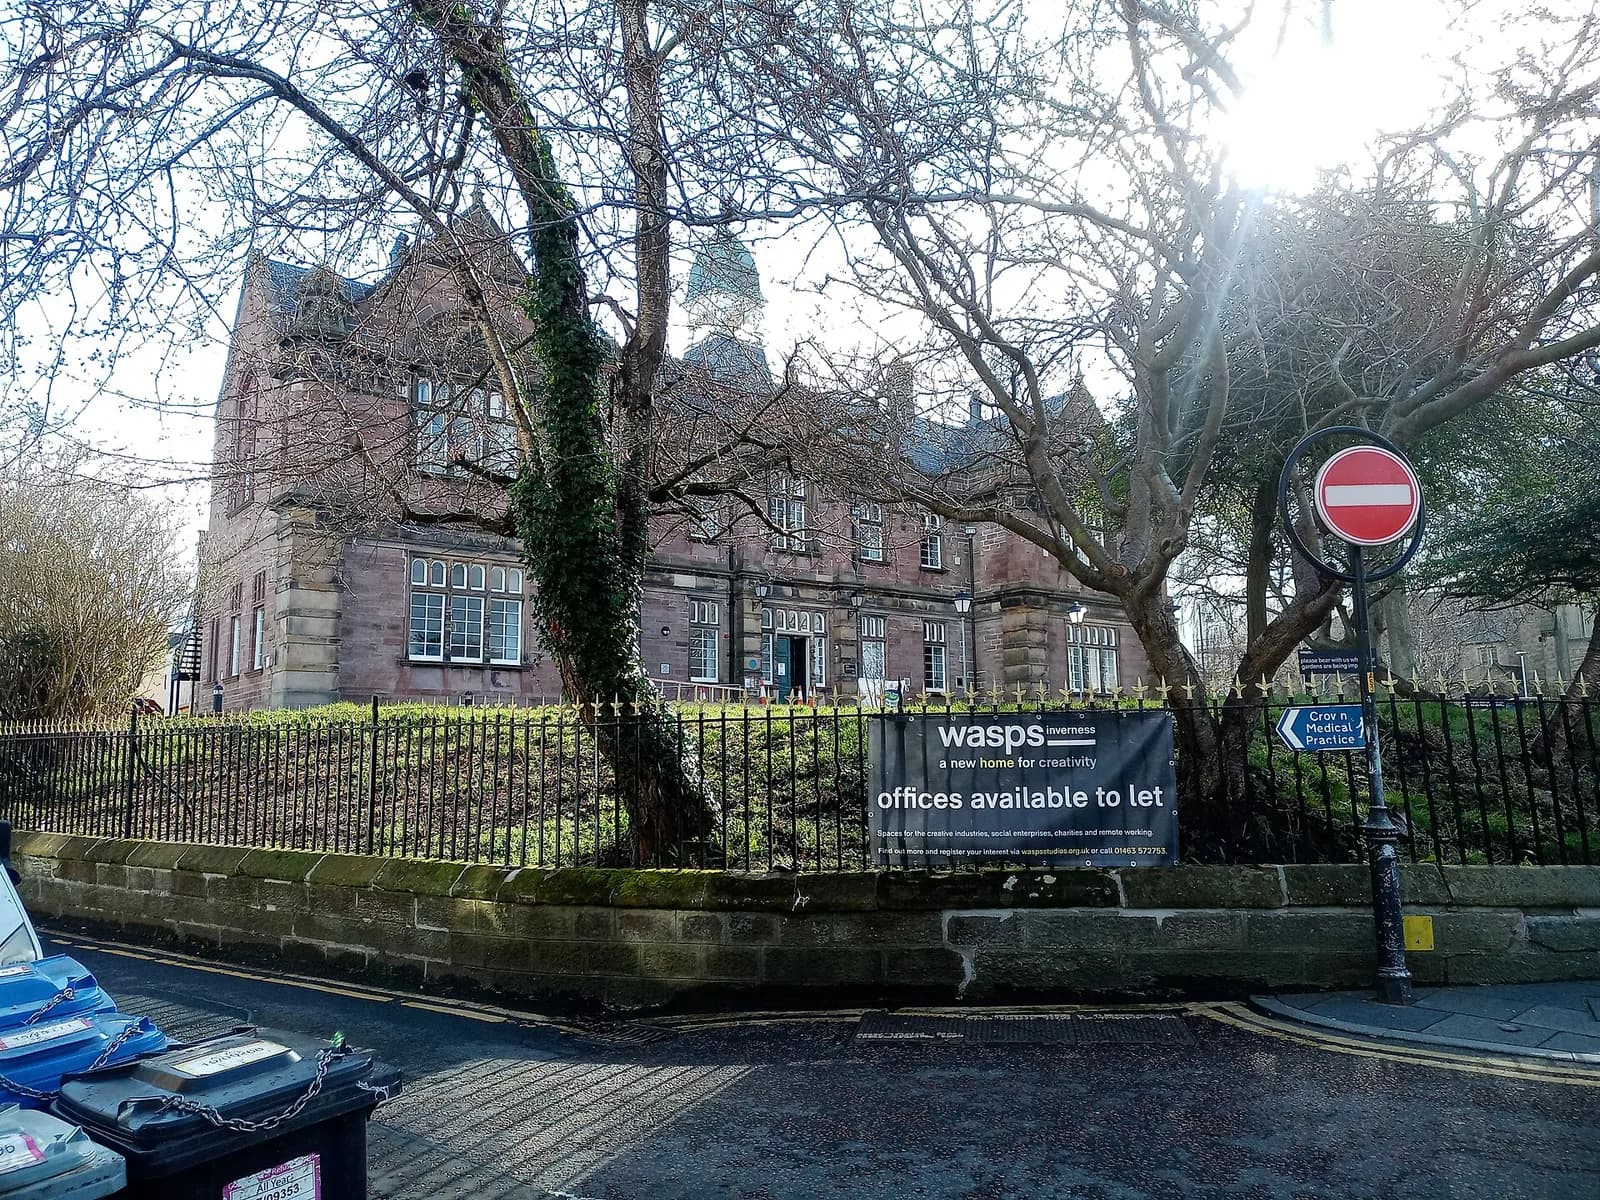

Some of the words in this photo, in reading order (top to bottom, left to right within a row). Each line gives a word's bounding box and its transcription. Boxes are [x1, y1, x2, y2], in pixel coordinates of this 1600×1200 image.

[1306, 722, 1352, 733] Medical
[938, 724, 1045, 755] wasps
[1046, 726, 1096, 734] inverness
[1306, 734, 1355, 745] Practice
[940, 760, 947, 768] a
[950, 760, 976, 768] new
[980, 757, 1014, 768] home
[1018, 757, 1035, 768] for
[1039, 756, 1097, 770] creativity
[878, 786, 963, 809] offices
[971, 786, 1088, 809] available
[1096, 786, 1121, 808] to
[1130, 784, 1164, 807] let
[877, 830, 903, 838] Spaces
[955, 830, 990, 838] industries,
[1013, 830, 1053, 838] enterprises,
[1124, 829, 1154, 837] working.
[939, 848, 965, 856] register
[966, 848, 982, 856] your
[257, 1182, 269, 1194] All
[271, 1176, 291, 1188] Year
